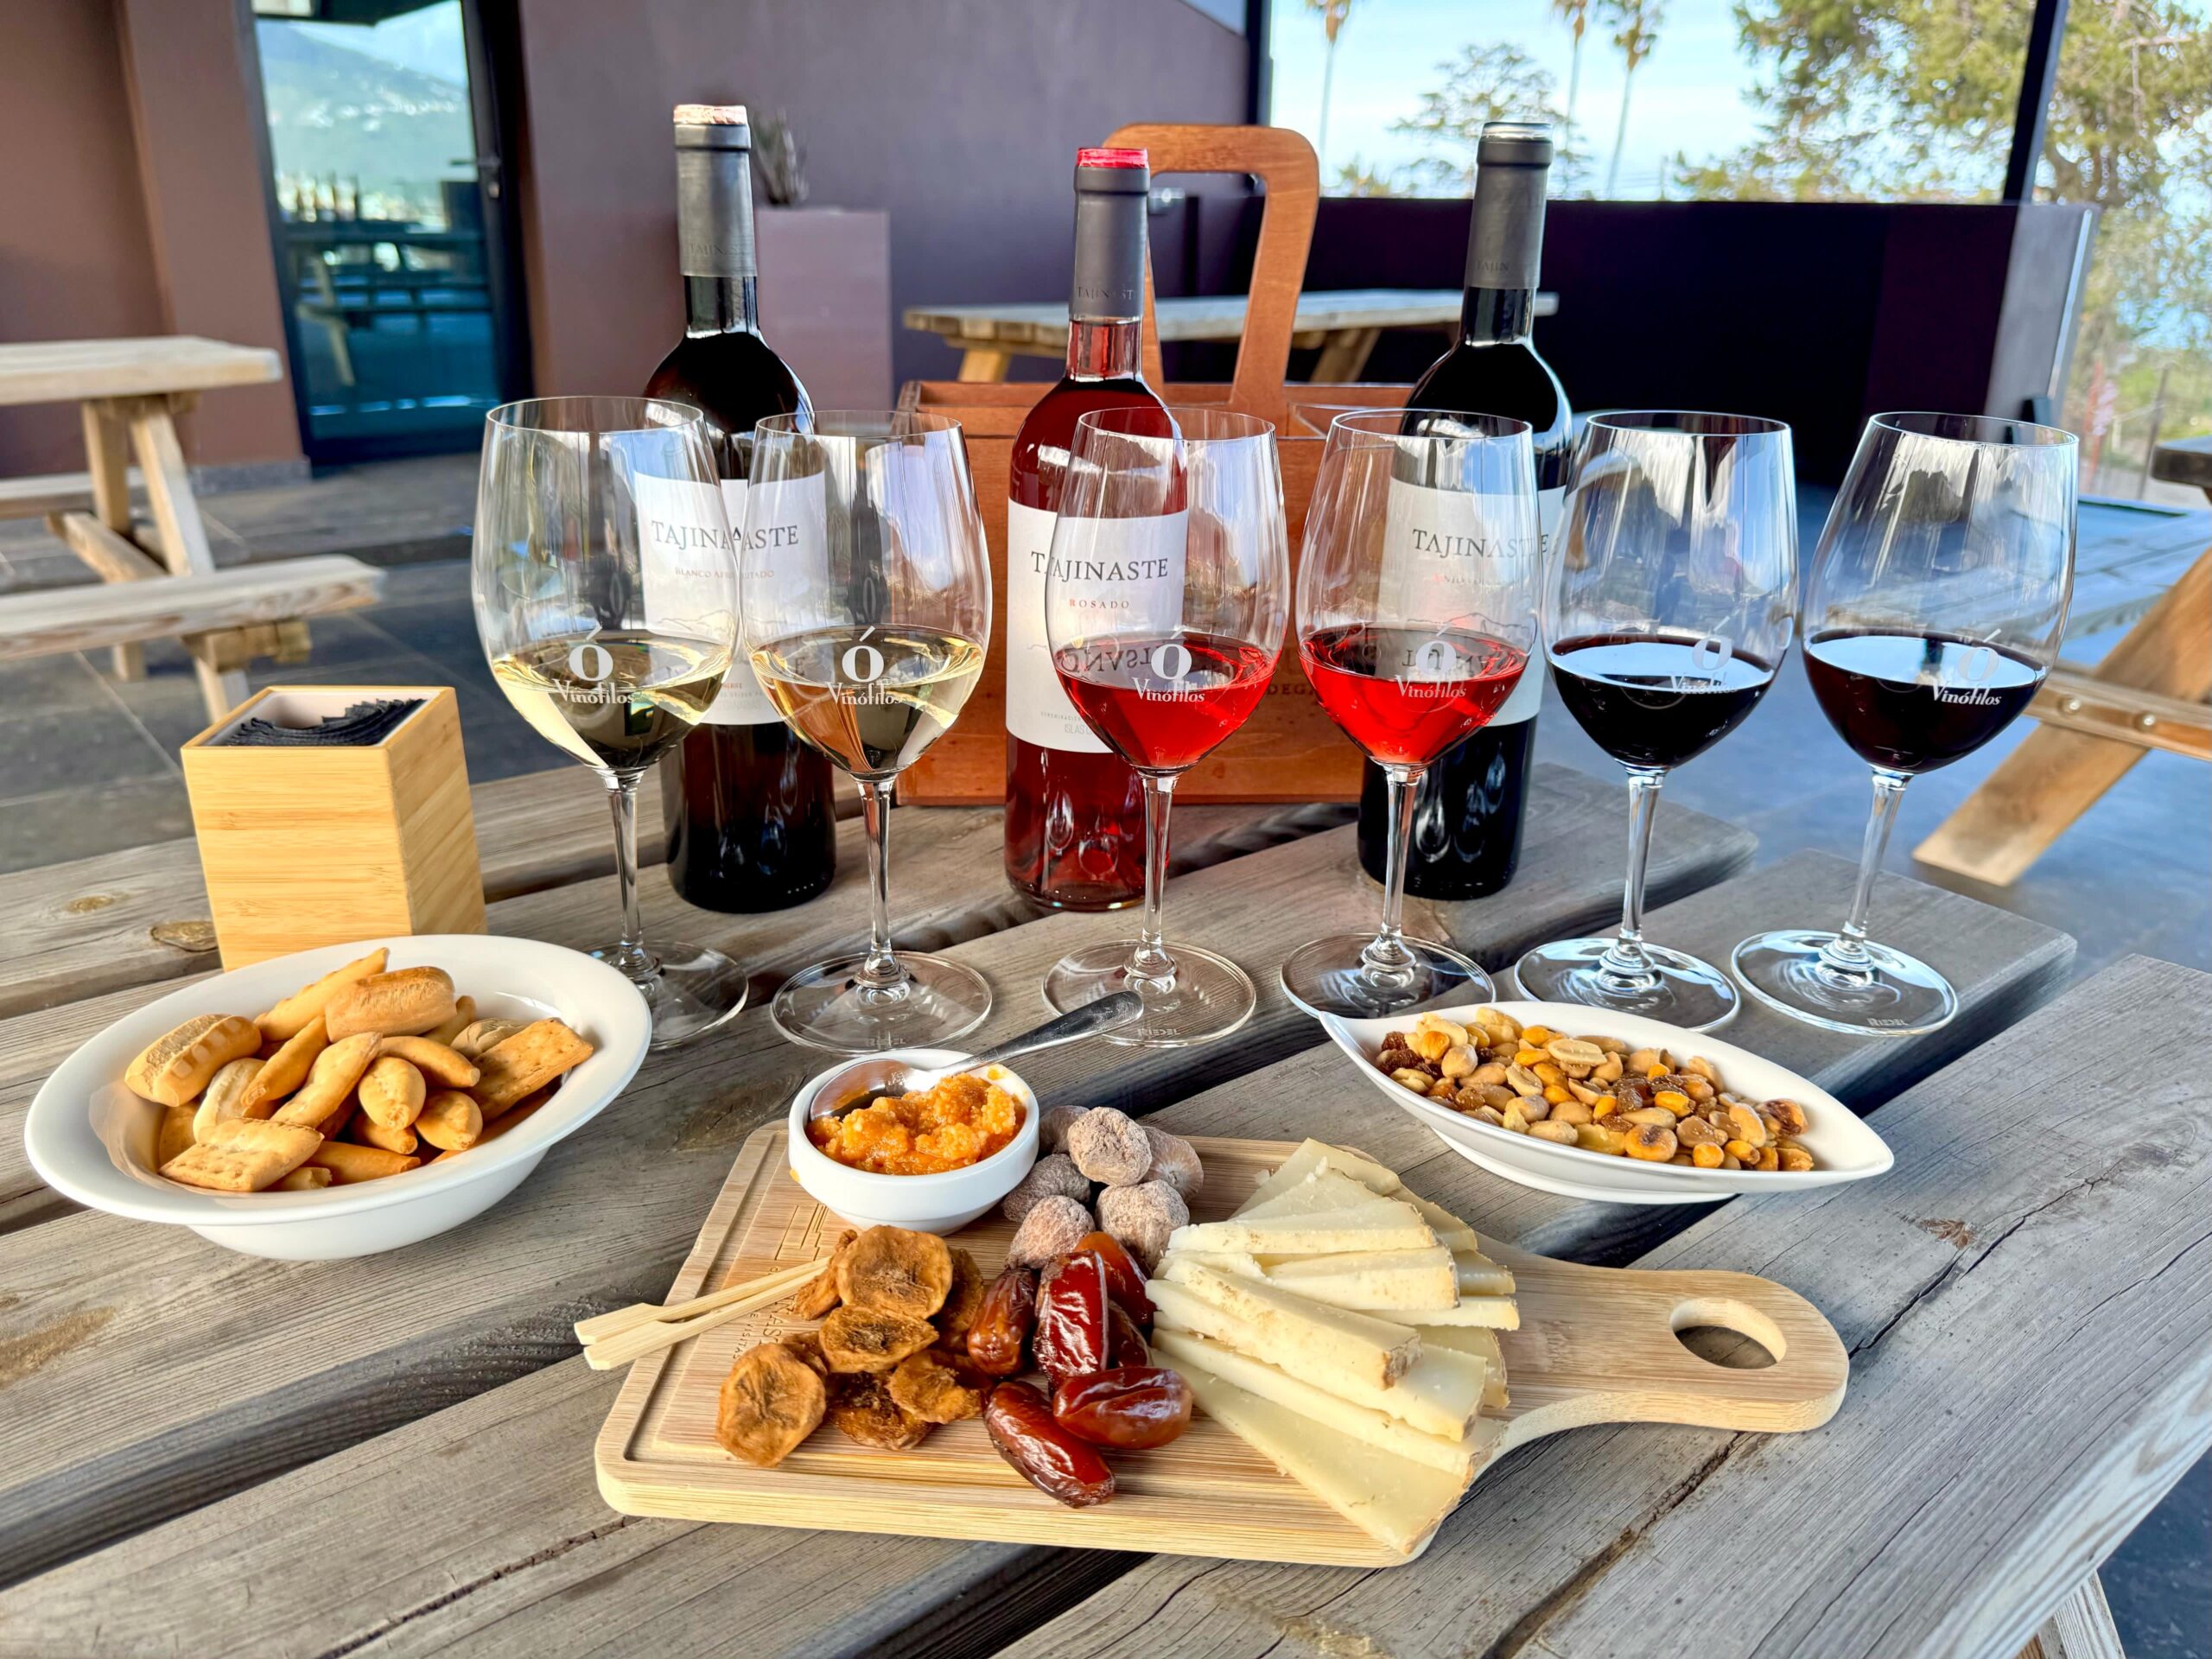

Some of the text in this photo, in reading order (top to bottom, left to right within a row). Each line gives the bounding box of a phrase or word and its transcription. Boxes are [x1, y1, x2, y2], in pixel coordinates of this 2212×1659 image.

[652, 520, 798, 550] TAJINASTE
[1031, 551, 1168, 582] TAJINASTE
[1069, 599, 1129, 609] ROSADO
[842, 626, 884, 682] Ó
[1151, 626, 1192, 680] Ó
[551, 678, 634, 703] Vinófilos
[825, 681, 899, 704] Vinófilos
[1131, 677, 1205, 702] Vinófilos
[1395, 675, 1466, 697] Vinófilos
[1929, 677, 2001, 705] Vinófilos
